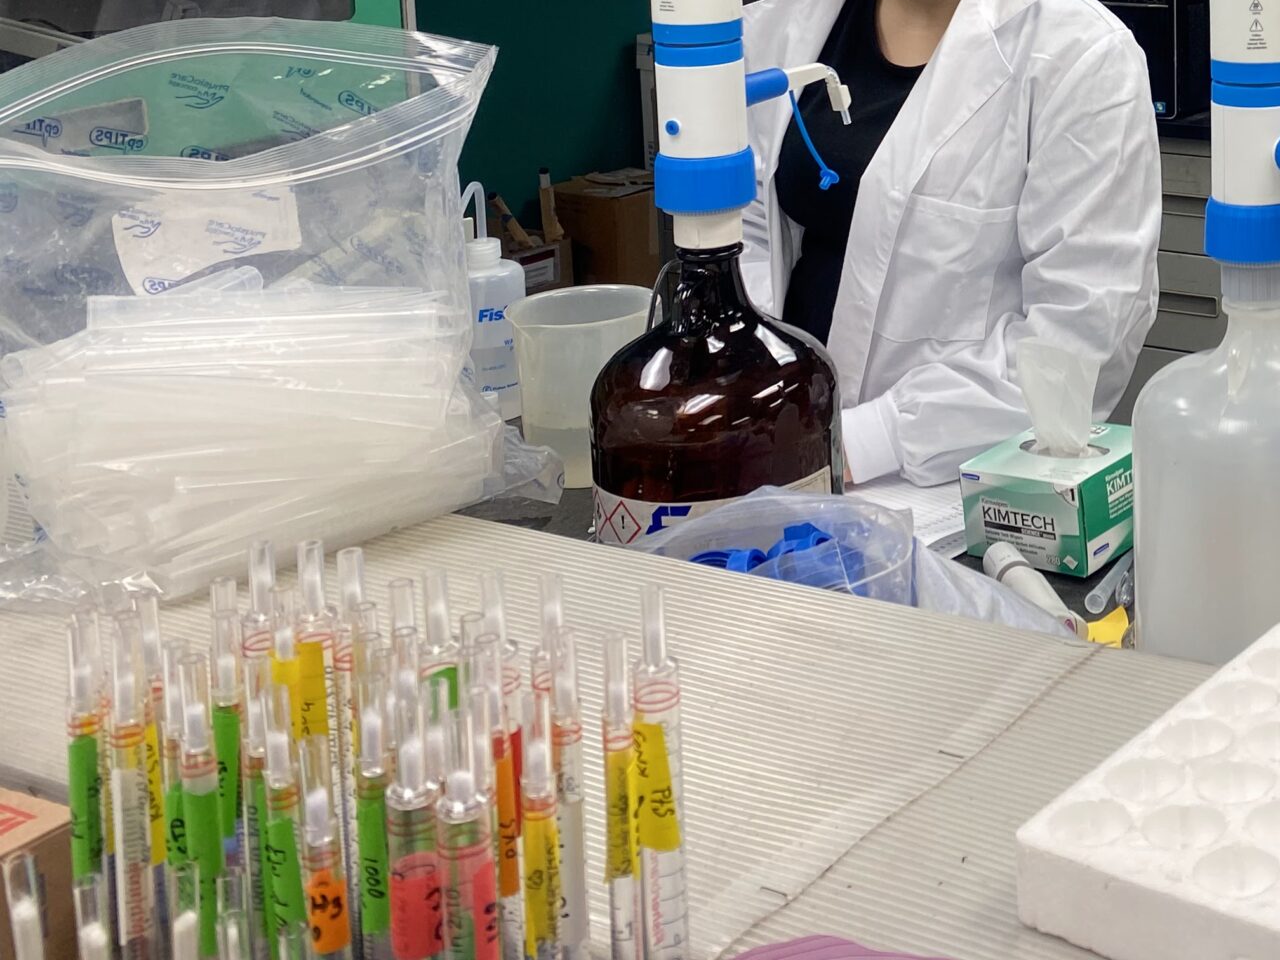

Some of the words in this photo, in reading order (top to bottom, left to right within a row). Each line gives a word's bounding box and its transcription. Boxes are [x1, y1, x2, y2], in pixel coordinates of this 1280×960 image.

[478, 308, 505, 323] Fis
[1106, 470, 1133, 495] KIMT
[982, 506, 1055, 531] KIMTECH
